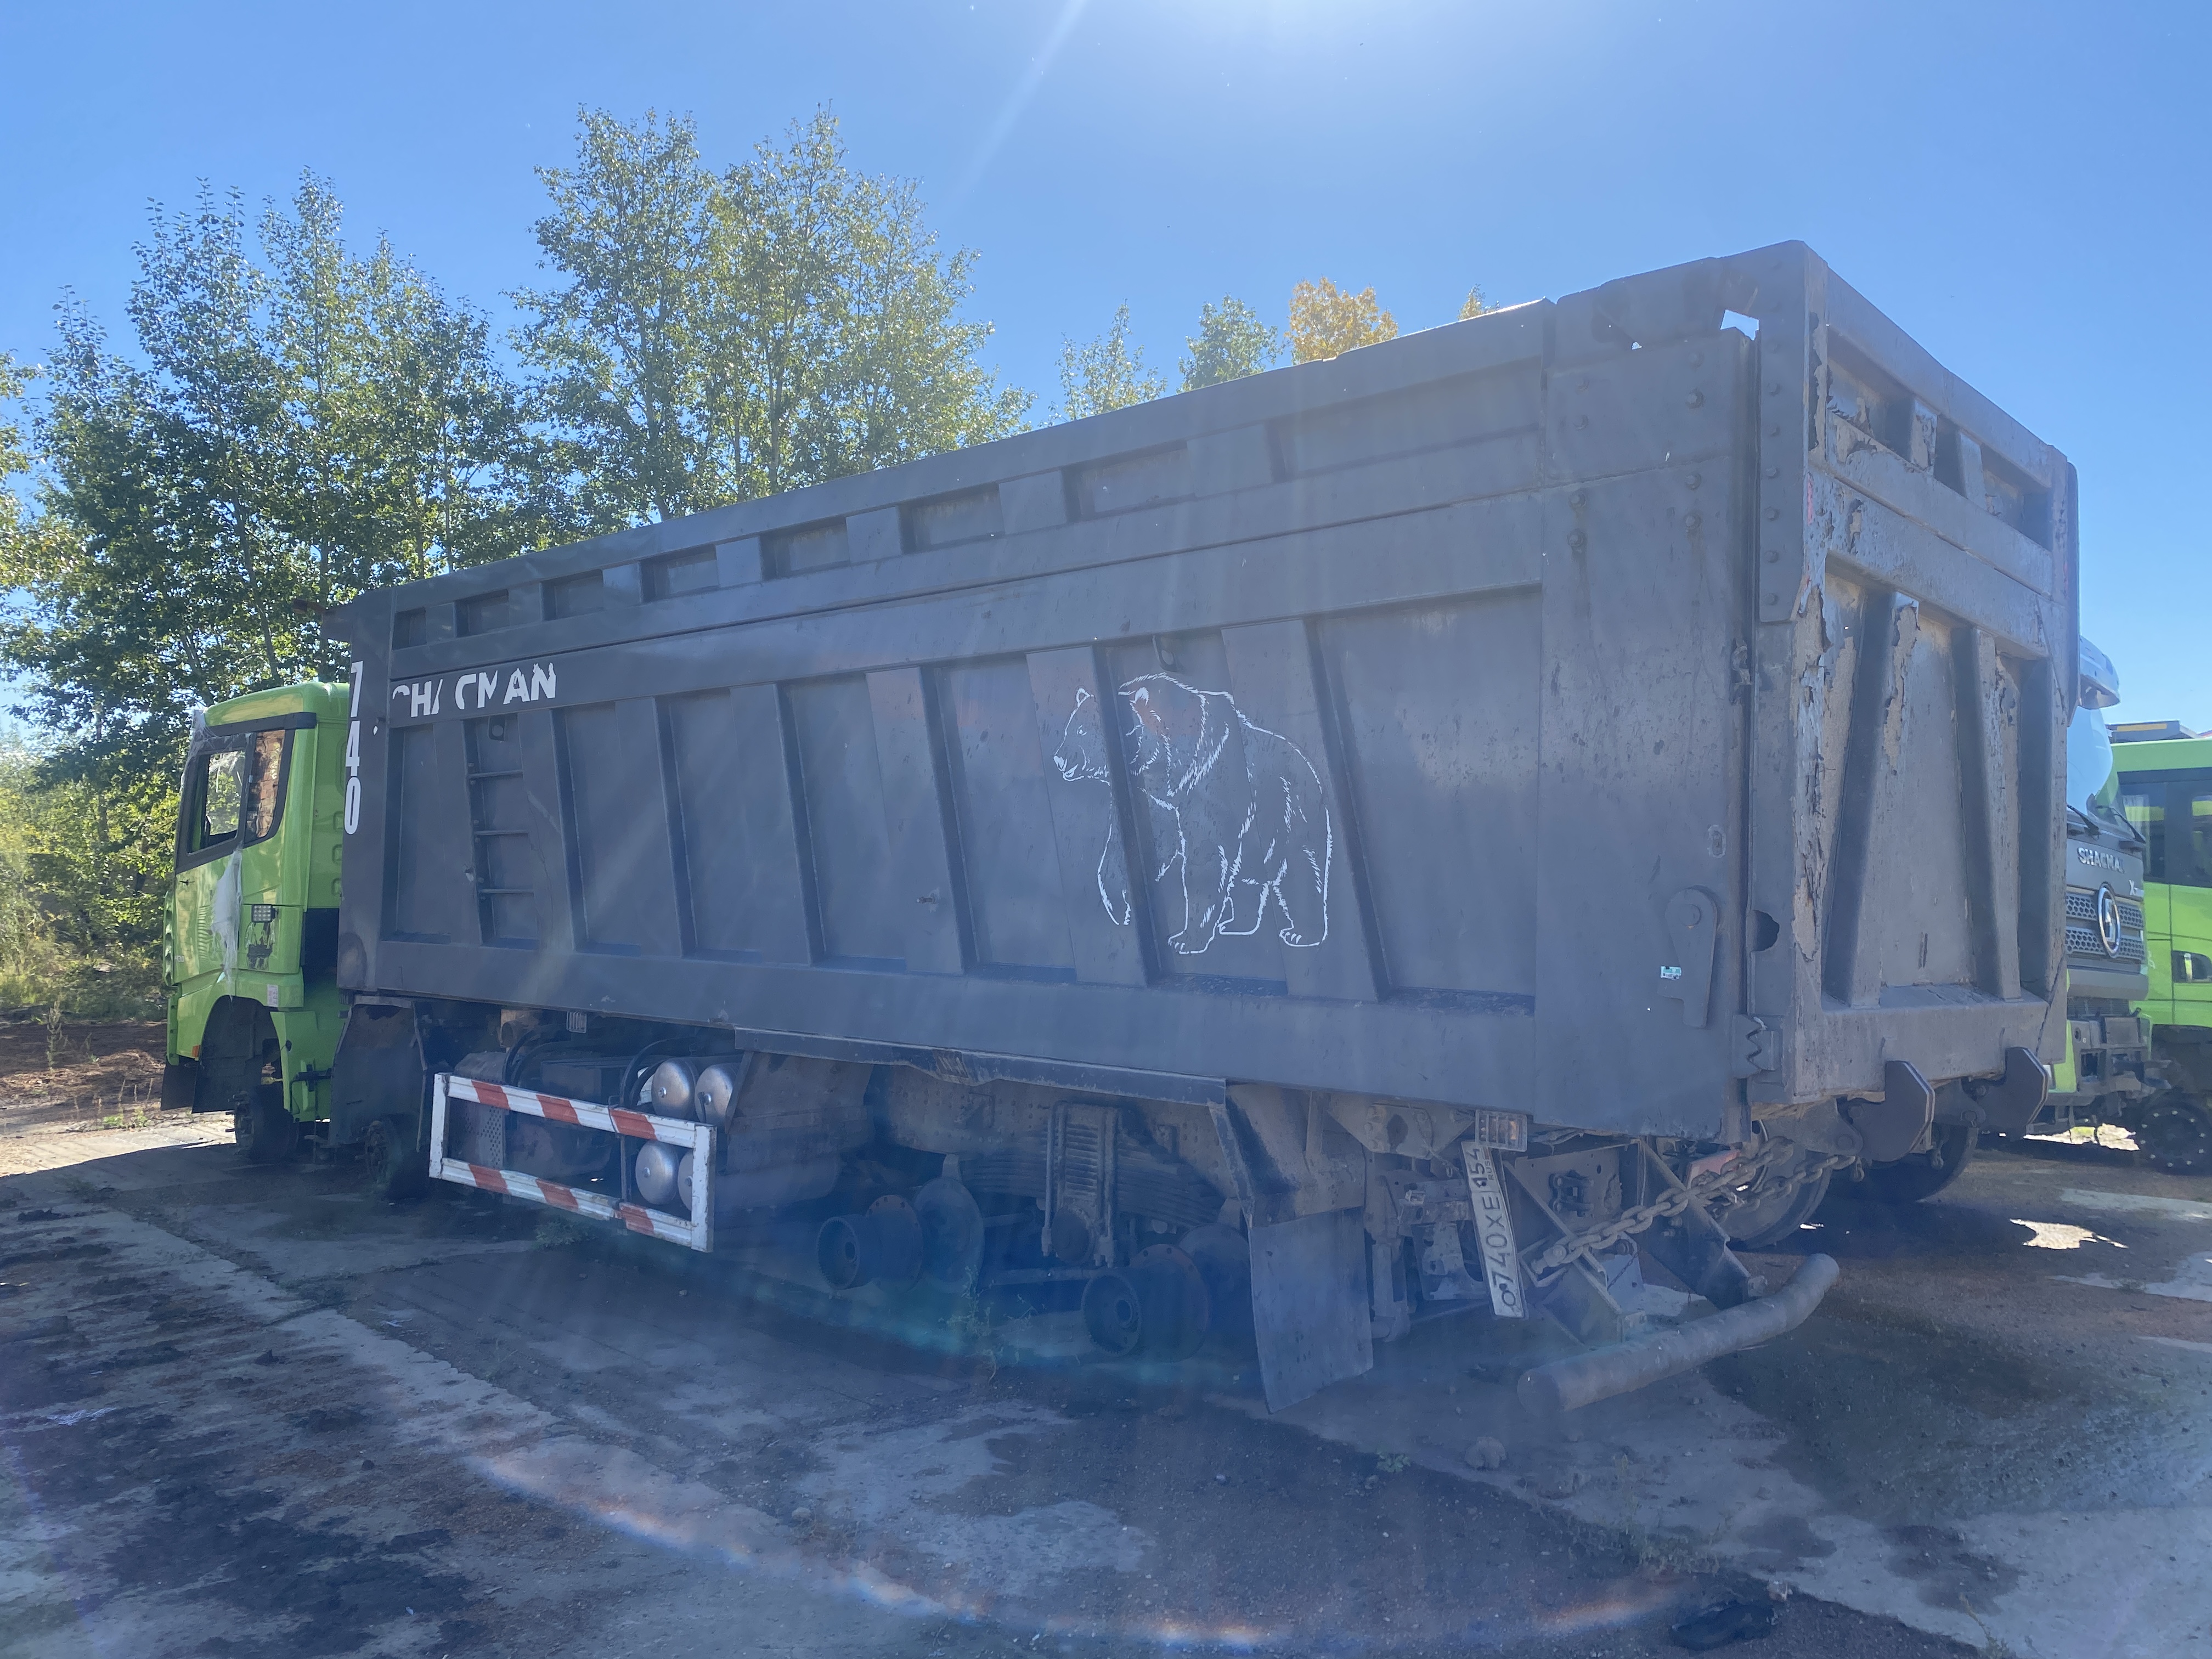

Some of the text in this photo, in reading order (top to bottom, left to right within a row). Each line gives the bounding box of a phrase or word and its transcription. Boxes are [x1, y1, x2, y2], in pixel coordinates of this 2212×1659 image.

[345, 661, 363, 834] 740
[1468, 1148, 1488, 1188] 154
[1485, 1160, 1494, 1181] RUS
